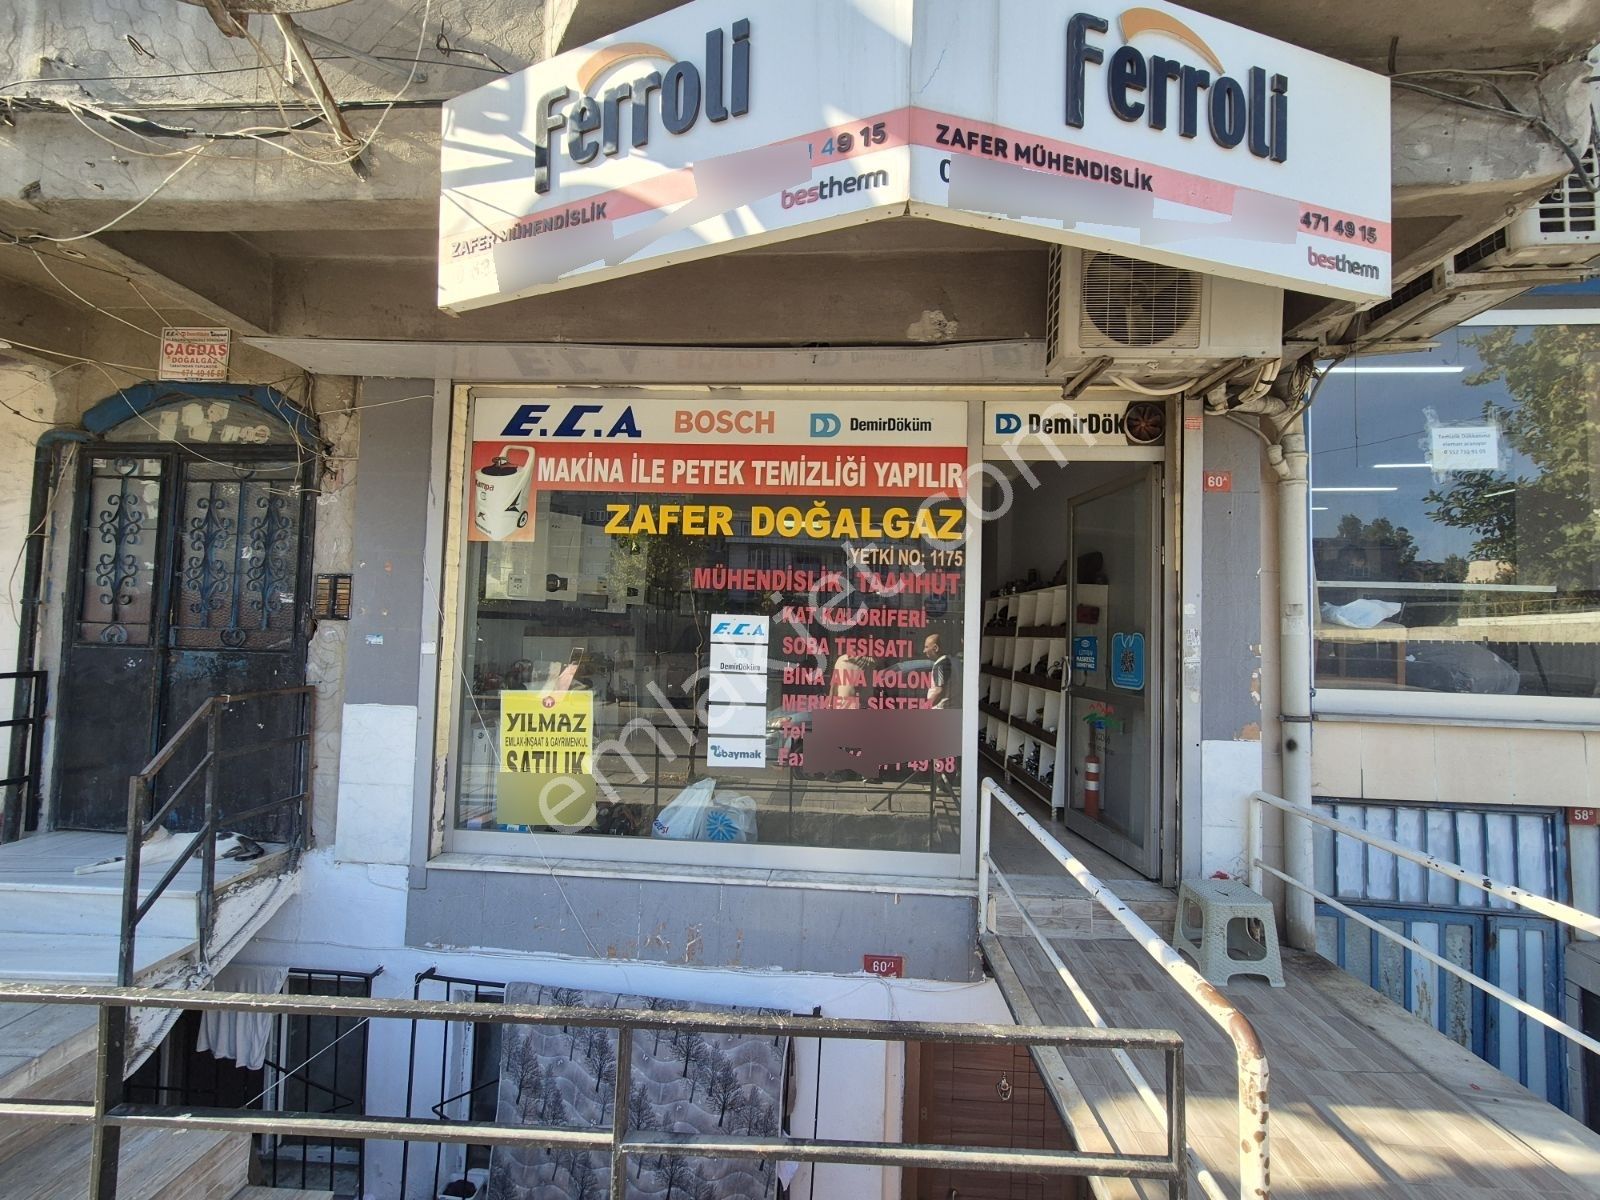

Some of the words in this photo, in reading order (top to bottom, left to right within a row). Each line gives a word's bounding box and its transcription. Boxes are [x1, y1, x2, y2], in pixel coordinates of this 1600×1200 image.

[1064, 12, 1288, 164] Ferroli
[936, 123, 1008, 158] ZAFER
[781, 169, 889, 210] bestherm
[1300, 211, 1329, 232] 471
[1334, 220, 1356, 238] 49
[1358, 225, 1377, 244] 15
[451, 232, 497, 257] ZAFER
[1308, 246, 1379, 280] bestherm
[674, 410, 774, 434] BOSCH
[850, 417, 932, 431] DemirDöküm
[537, 451, 624, 483] MAKİNA
[631, 453, 665, 484] İLE
[672, 459, 745, 486] PETEK
[751, 455, 866, 487] TEMİZLİĞİ
[874, 462, 963, 488] YAPILIR
[604, 504, 734, 536] ZAFER
[751, 500, 963, 540] DOĞALGAZ
[850, 546, 895, 565] YETKİ
[899, 550, 925, 566] NO:
[930, 551, 963, 567] 1175
[694, 564, 842, 593] MÜHENDİSLİK
[857, 569, 960, 595] TAAHHÜT
[782, 606, 817, 624] KAT
[822, 605, 927, 628] KALORİFERİ
[782, 637, 830, 656] SOBA
[835, 635, 913, 658] TESİSATI
[783, 663, 825, 685] BİNA
[830, 669, 867, 687] ANA
[873, 670, 933, 689] KOLON
[506, 713, 587, 732] YILMAZ
[506, 751, 586, 774] SATILIK
[722, 750, 761, 760] baymak
